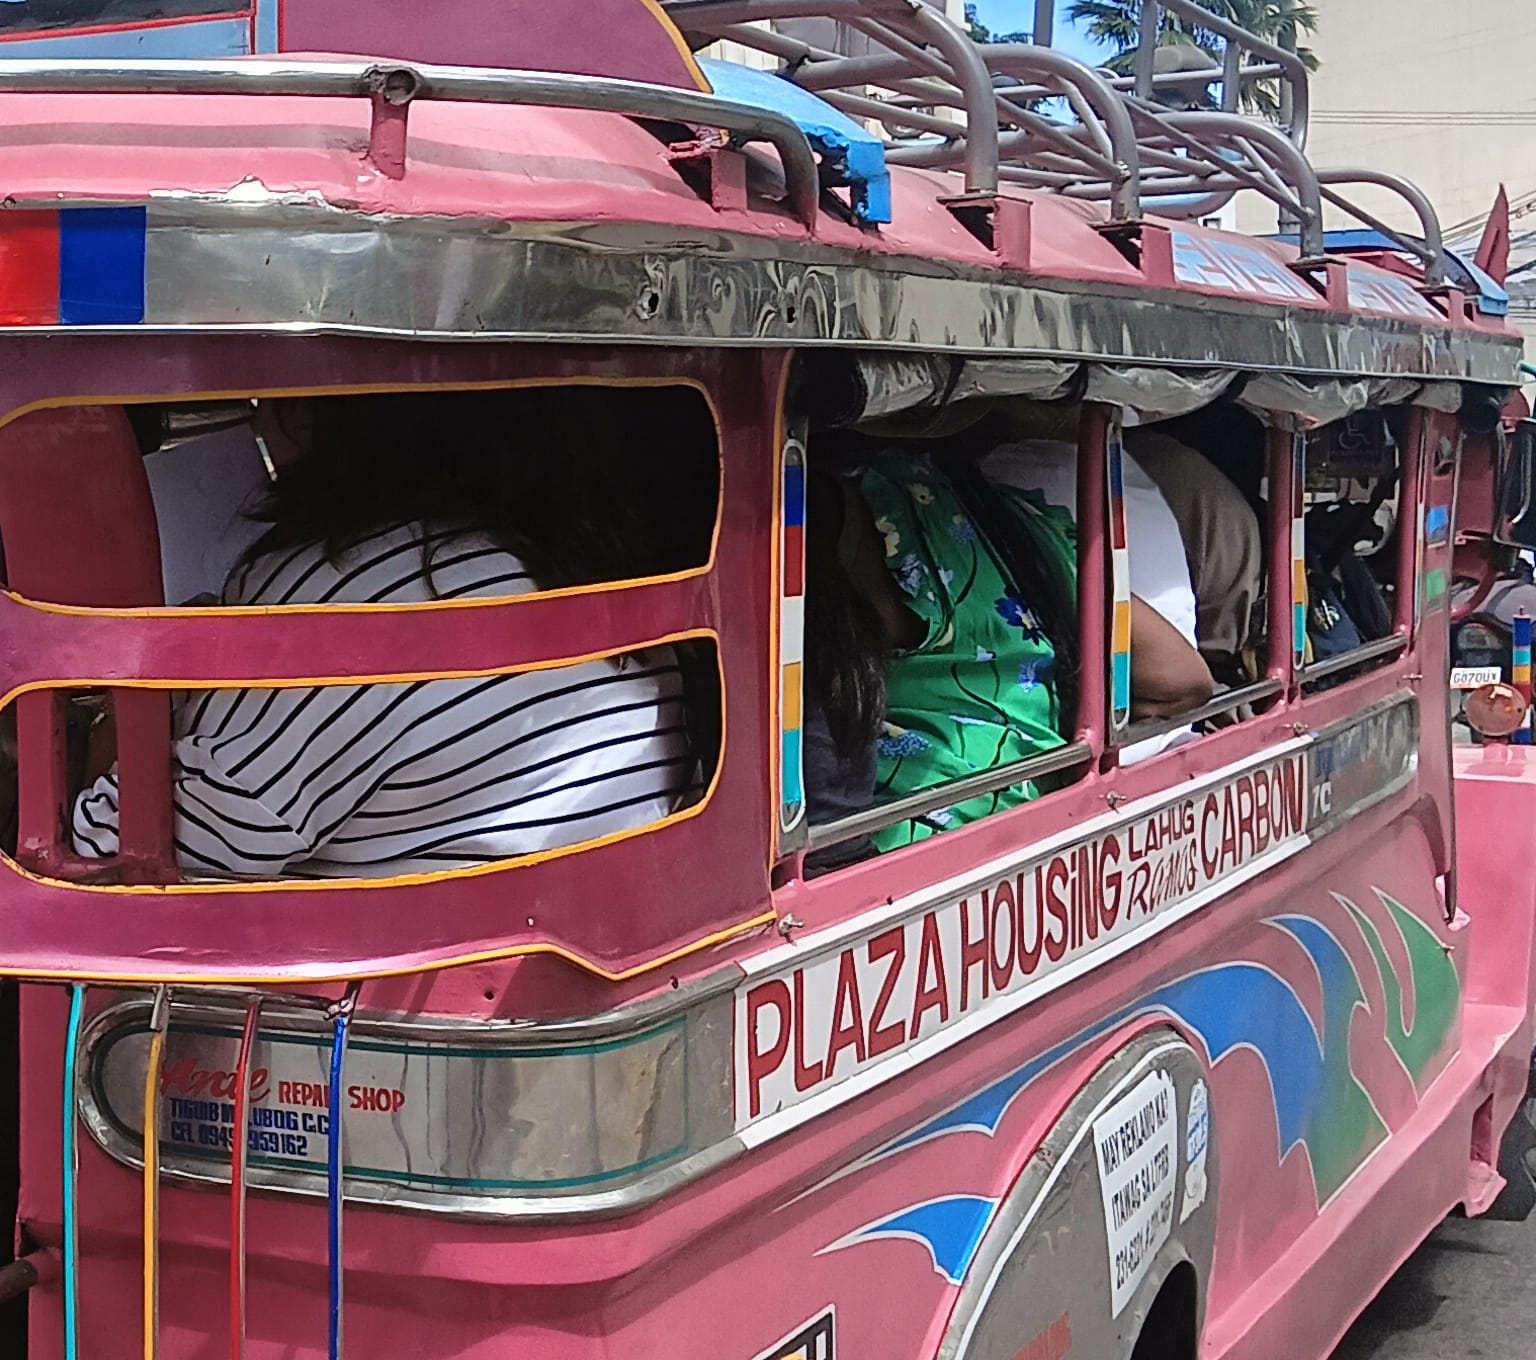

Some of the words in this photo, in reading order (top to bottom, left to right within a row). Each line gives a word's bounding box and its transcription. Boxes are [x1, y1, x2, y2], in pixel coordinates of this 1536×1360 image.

[1128, 799, 1195, 862] LAHUG
[1200, 754, 1305, 881] CARBON
[746, 912, 949, 1119] PLAZA
[278, 1080, 331, 1109] REPAI
[348, 1085, 407, 1113] SHOP
[1100, 1134, 1122, 1178] MAY
